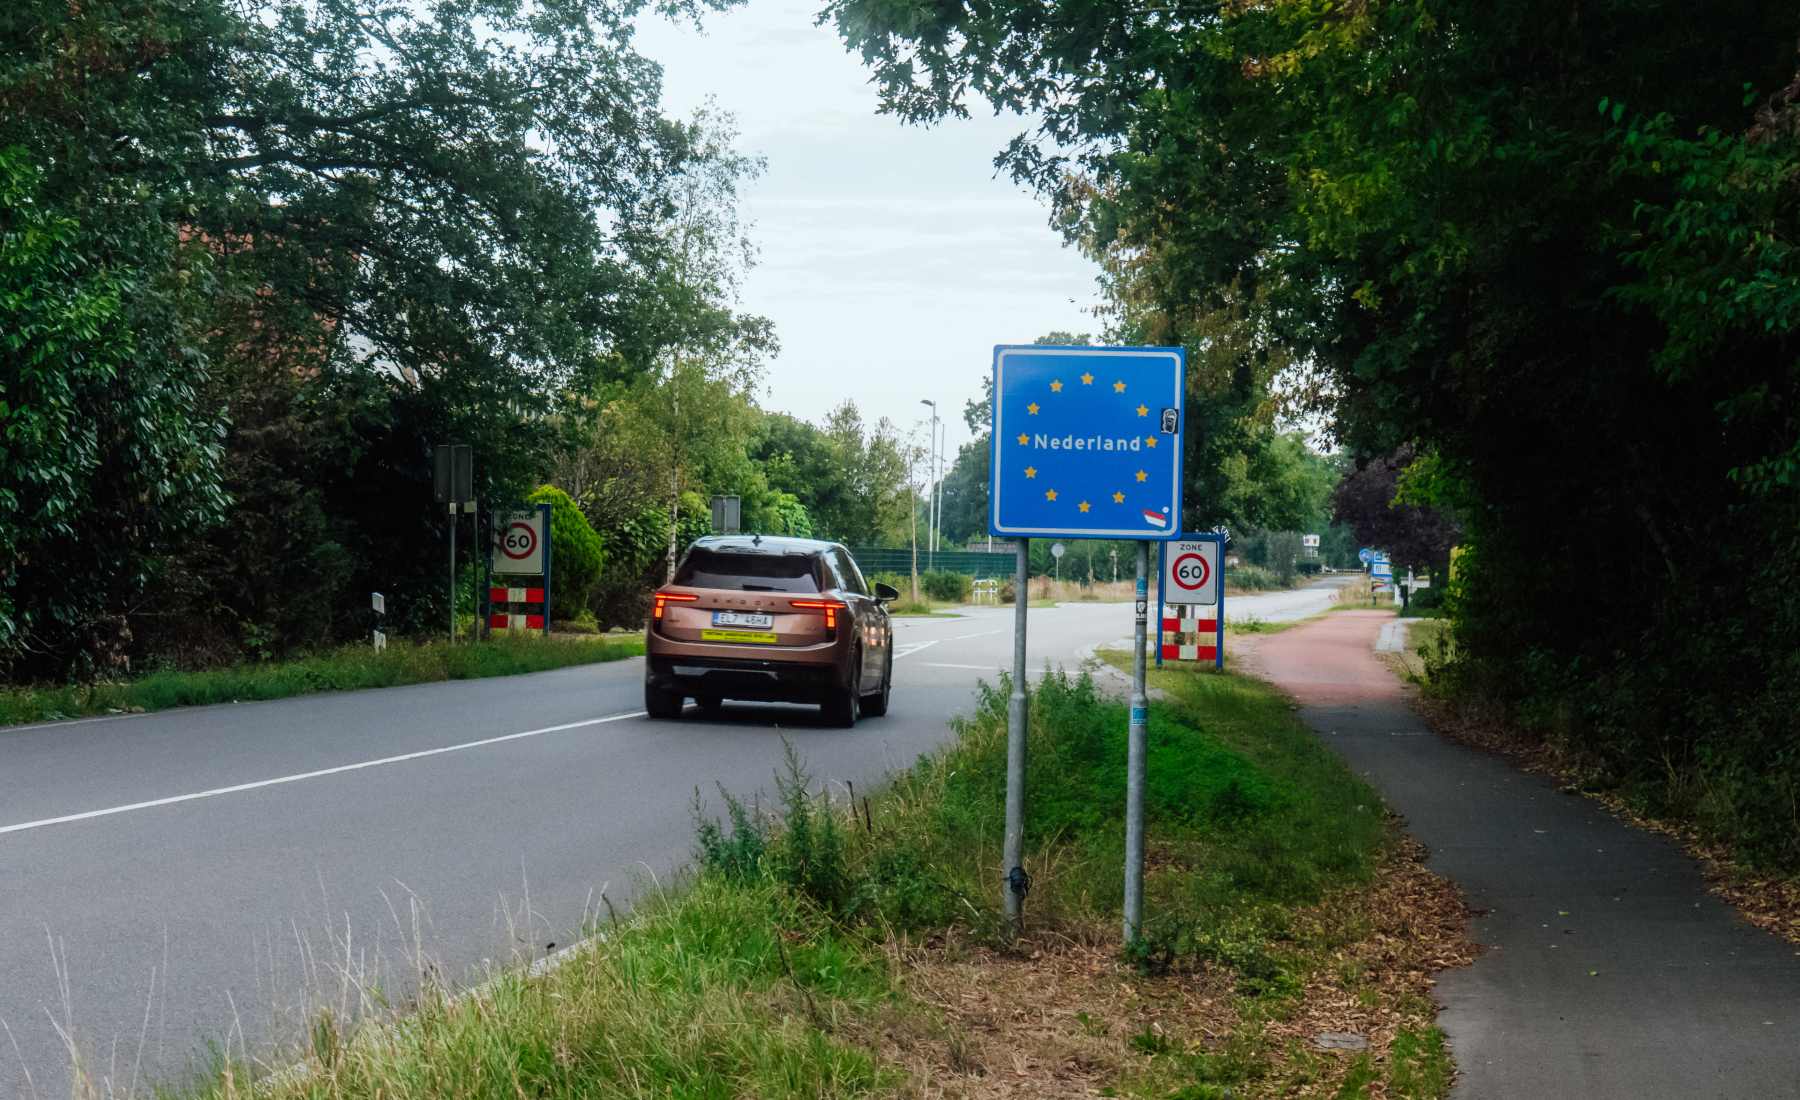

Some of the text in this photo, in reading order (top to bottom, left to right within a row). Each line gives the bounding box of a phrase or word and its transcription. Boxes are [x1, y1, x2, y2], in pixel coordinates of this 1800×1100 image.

[1034, 434, 1141, 451] Nederland
[506, 534, 530, 548] 60
[1179, 543, 1203, 551] ZONE
[1178, 565, 1203, 579] 60
